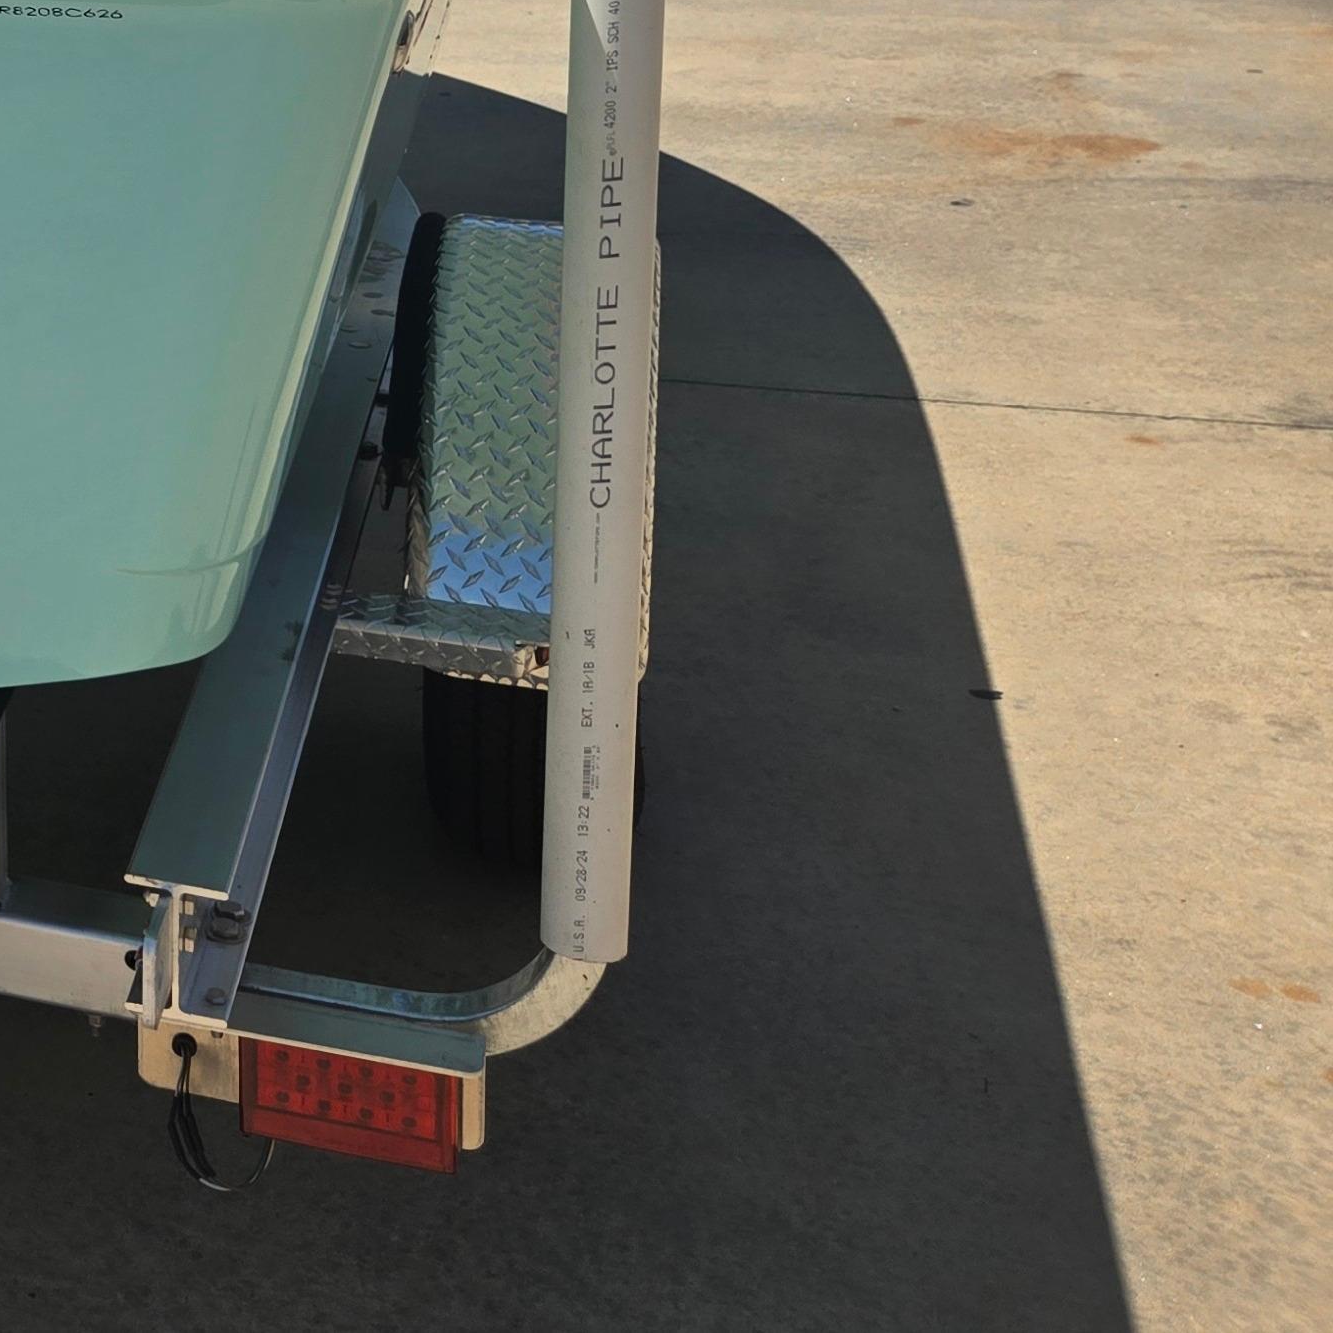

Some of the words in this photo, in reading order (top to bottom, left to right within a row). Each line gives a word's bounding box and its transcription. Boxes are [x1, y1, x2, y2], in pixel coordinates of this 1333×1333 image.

[608, 1, 621, 15] 40
[608, 21, 620, 44] SCH
[605, 100, 617, 129] 4200
[598, 156, 624, 260] PIPE
[589, 285, 619, 509] CHARLOTTE
[583, 629, 596, 649] JKA
[582, 661, 595, 694] 1A/1B
[581, 701, 594, 728] EXT.
[577, 805, 590, 837] 13:22
[575, 850, 588, 902] 09/28/24
[573, 914, 586, 953] U.S.A.
